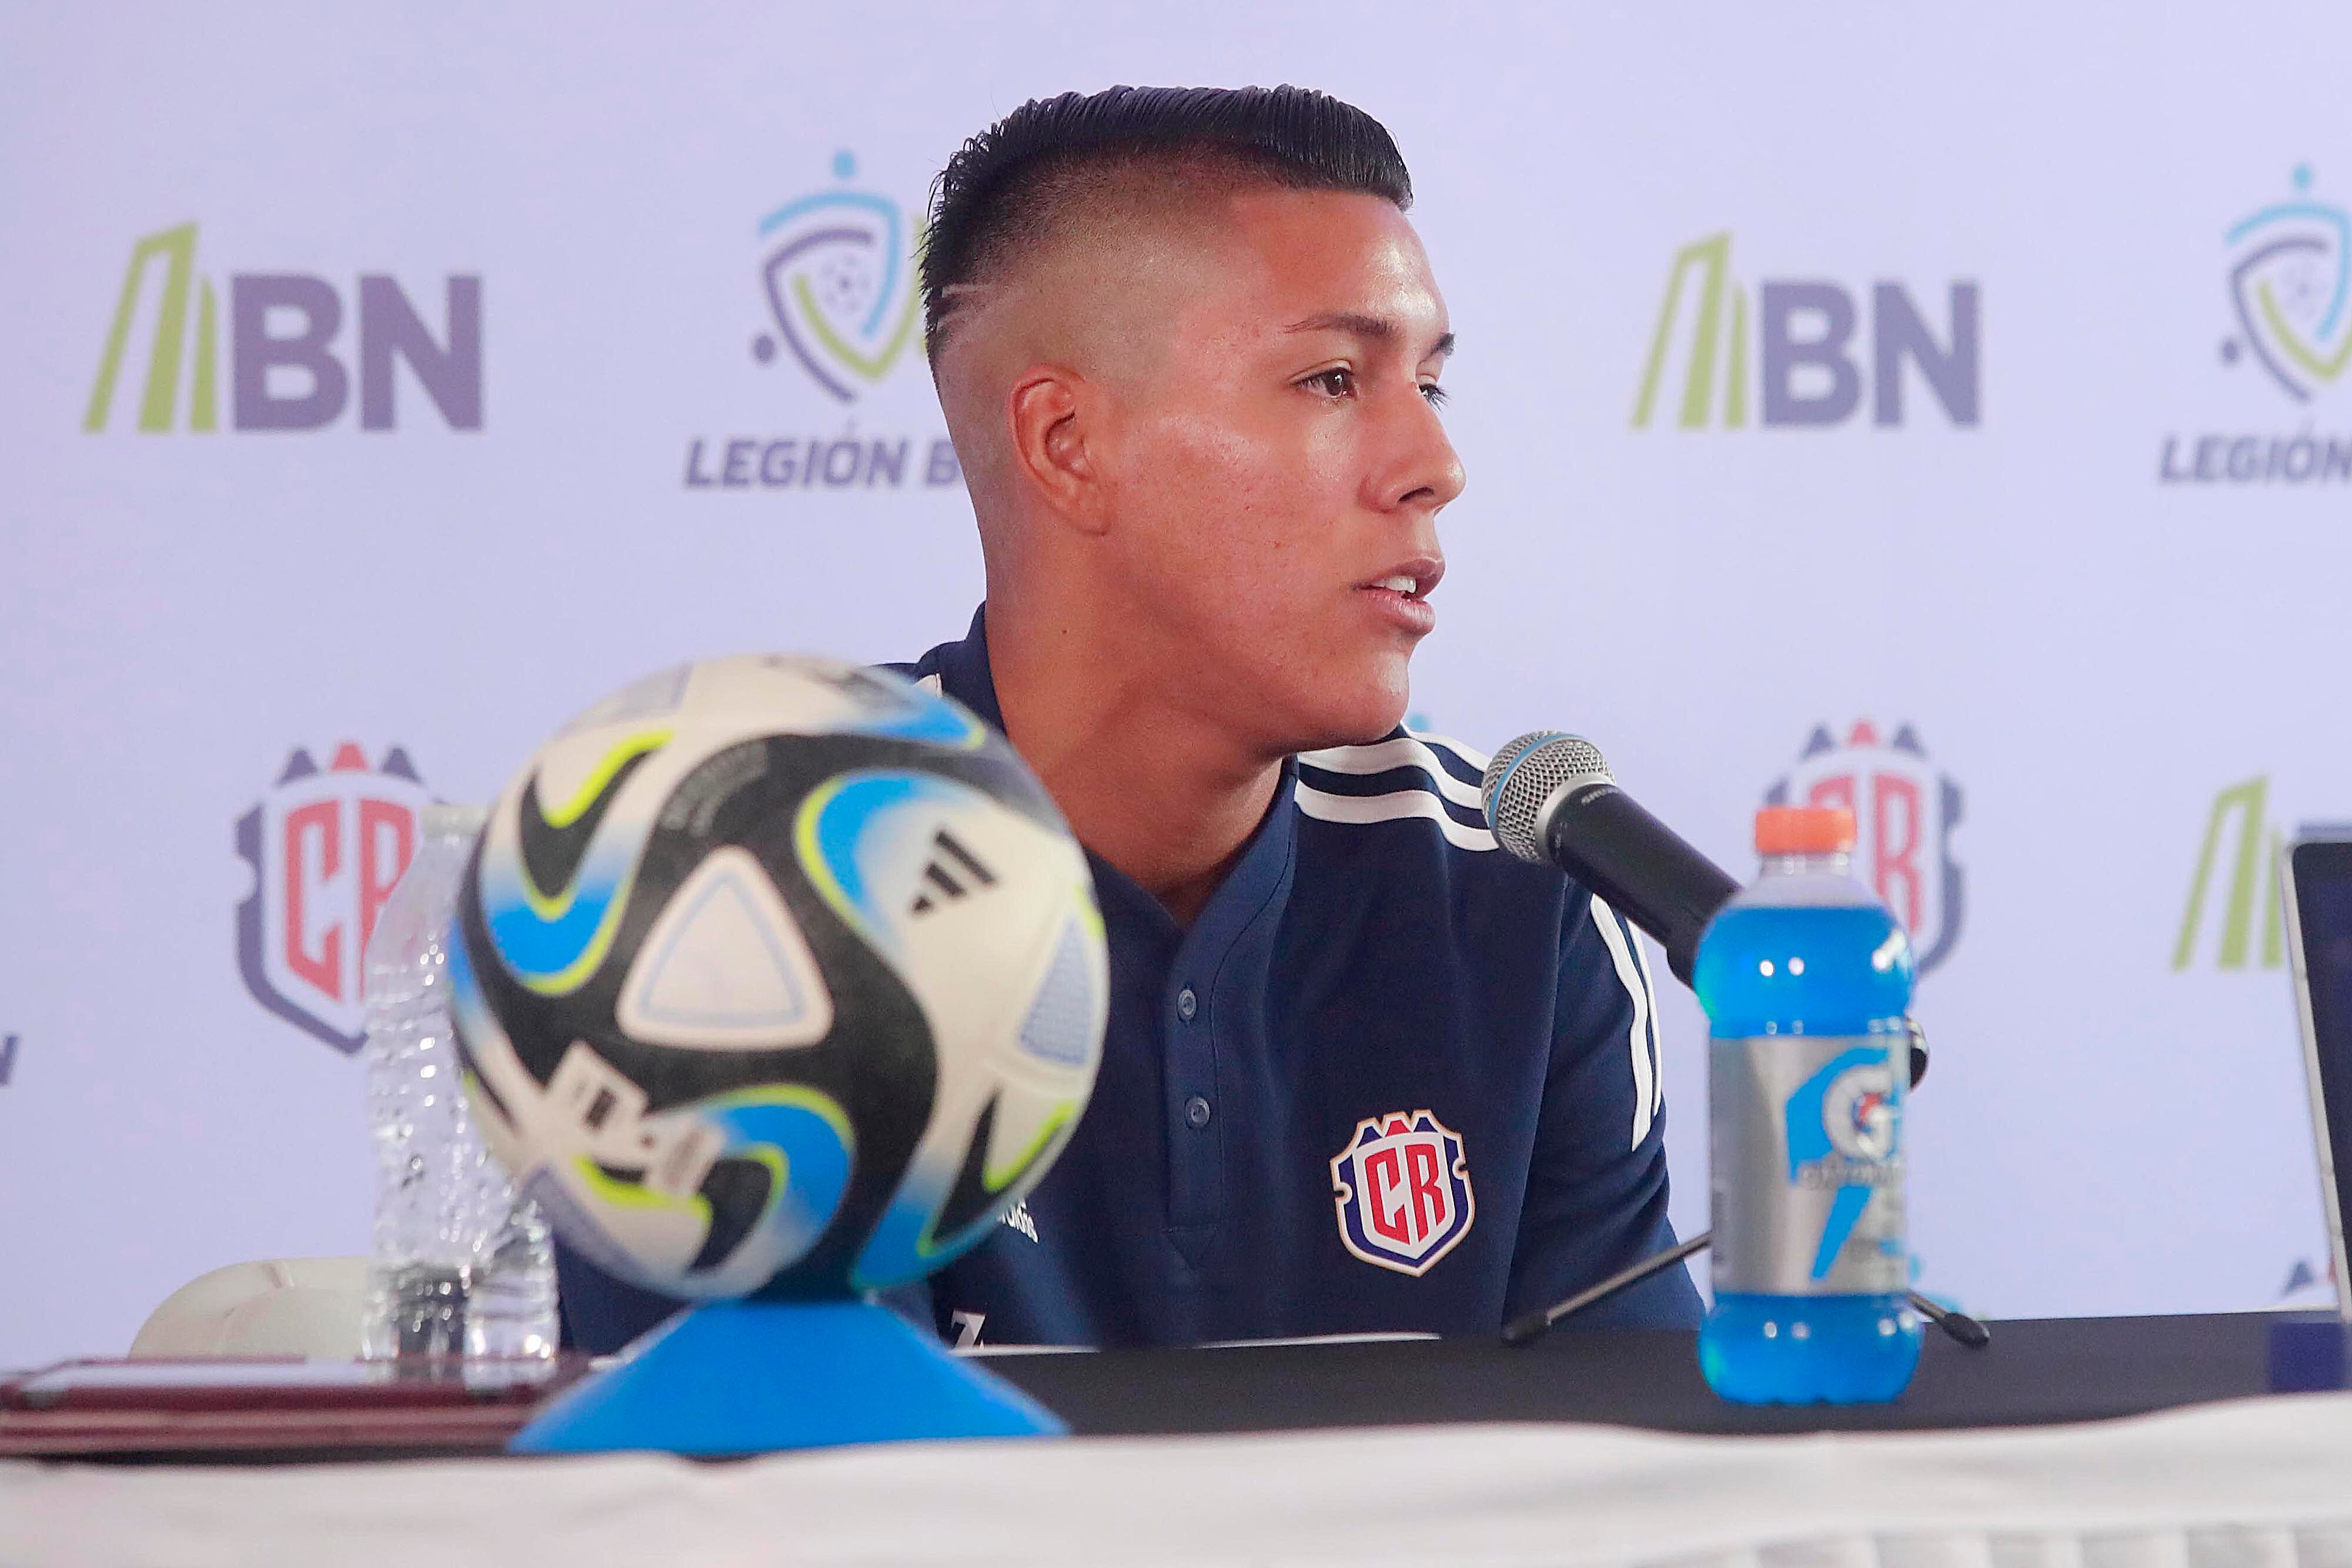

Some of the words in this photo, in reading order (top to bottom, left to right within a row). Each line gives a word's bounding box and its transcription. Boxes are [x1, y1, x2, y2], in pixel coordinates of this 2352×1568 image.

[232, 273, 482, 432] BN
[1760, 280, 1980, 427] BN
[684, 419, 906, 487] LEGIÓN
[1364, 1144, 1446, 1245] CR
